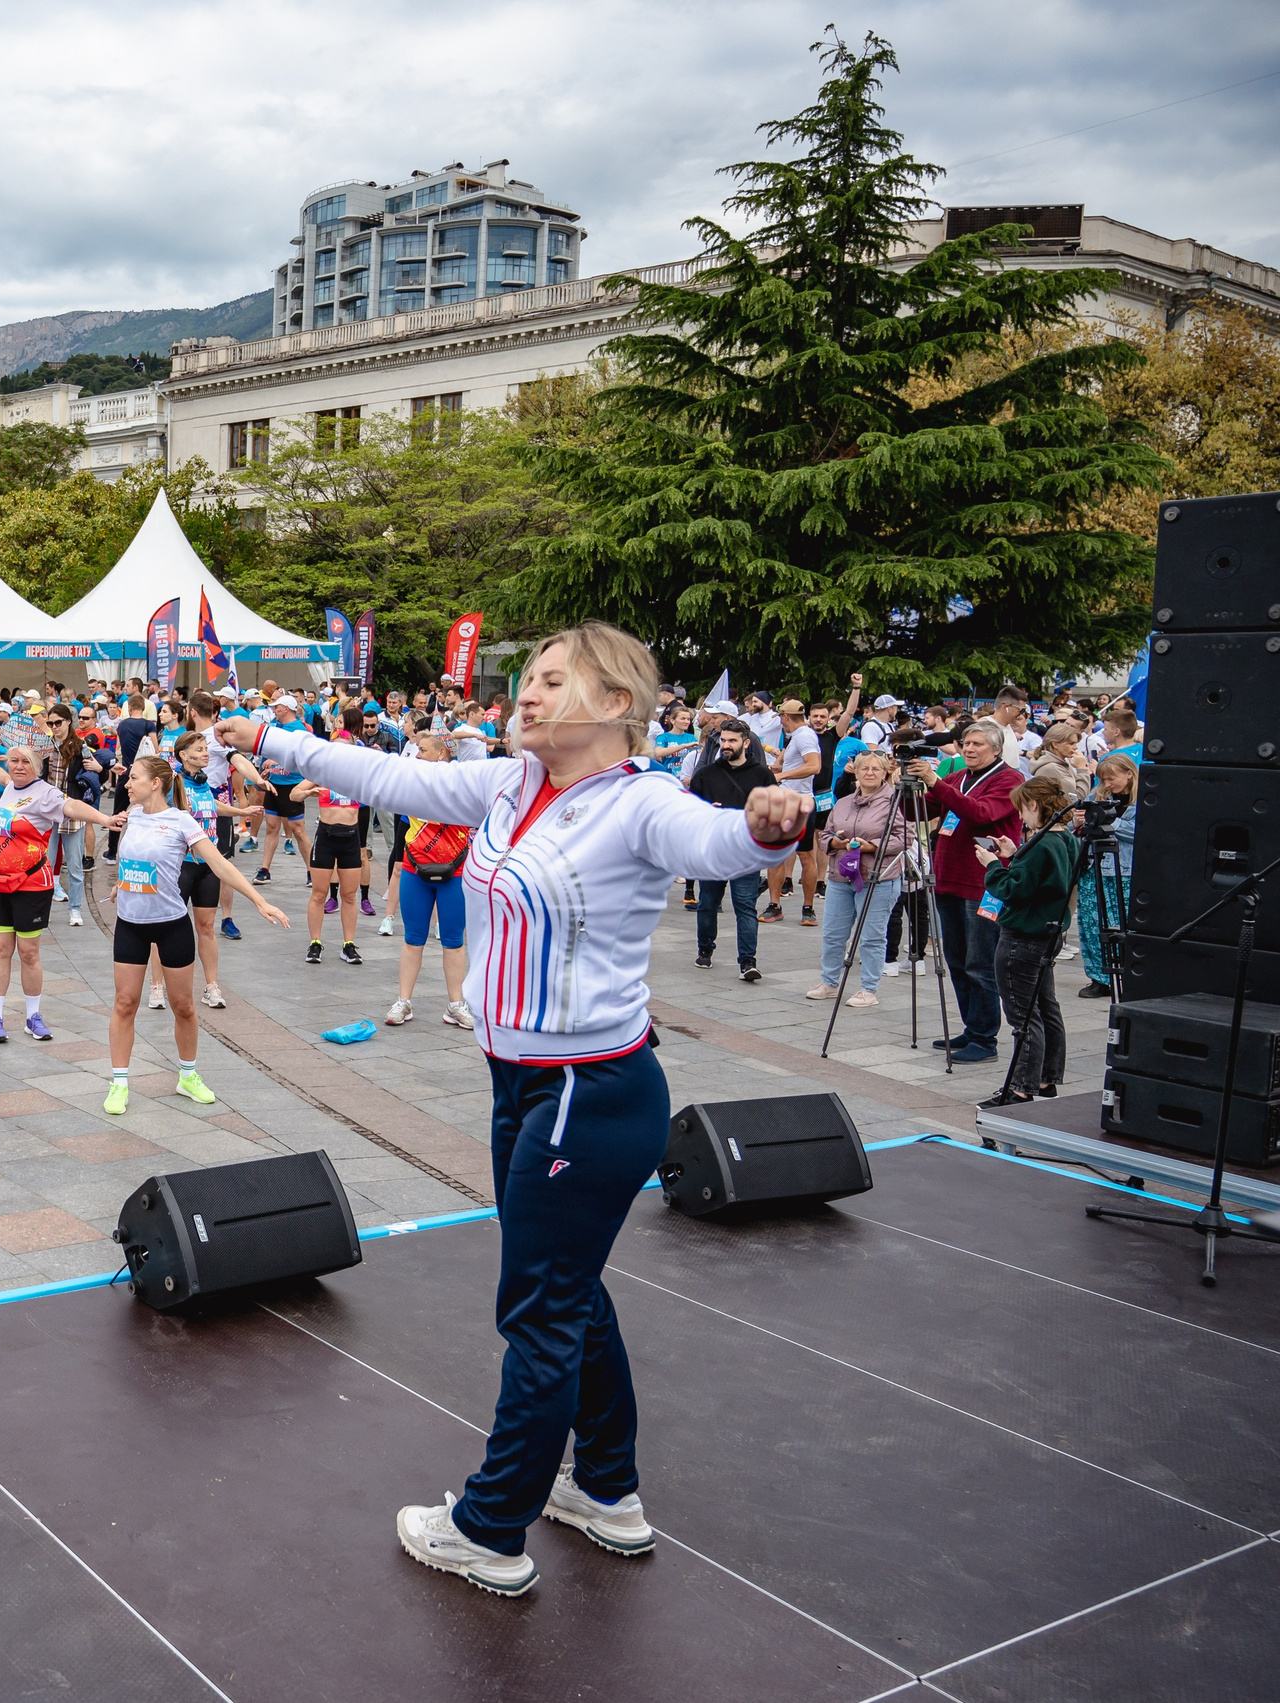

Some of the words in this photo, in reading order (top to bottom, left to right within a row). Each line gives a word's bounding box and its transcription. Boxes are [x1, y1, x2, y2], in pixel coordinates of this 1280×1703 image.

[26, 645, 73, 659] ПЕРЕВОДНОЕ
[73, 645, 91, 658] ТАТУ
[178, 645, 202, 658] АССАЖ
[261, 646, 310, 659] ТЕЙПИРОВАНИЕ
[154, 624, 170, 700] MAGUCHI
[125, 869, 150, 883] 20250
[130, 883, 143, 893] 5KM
